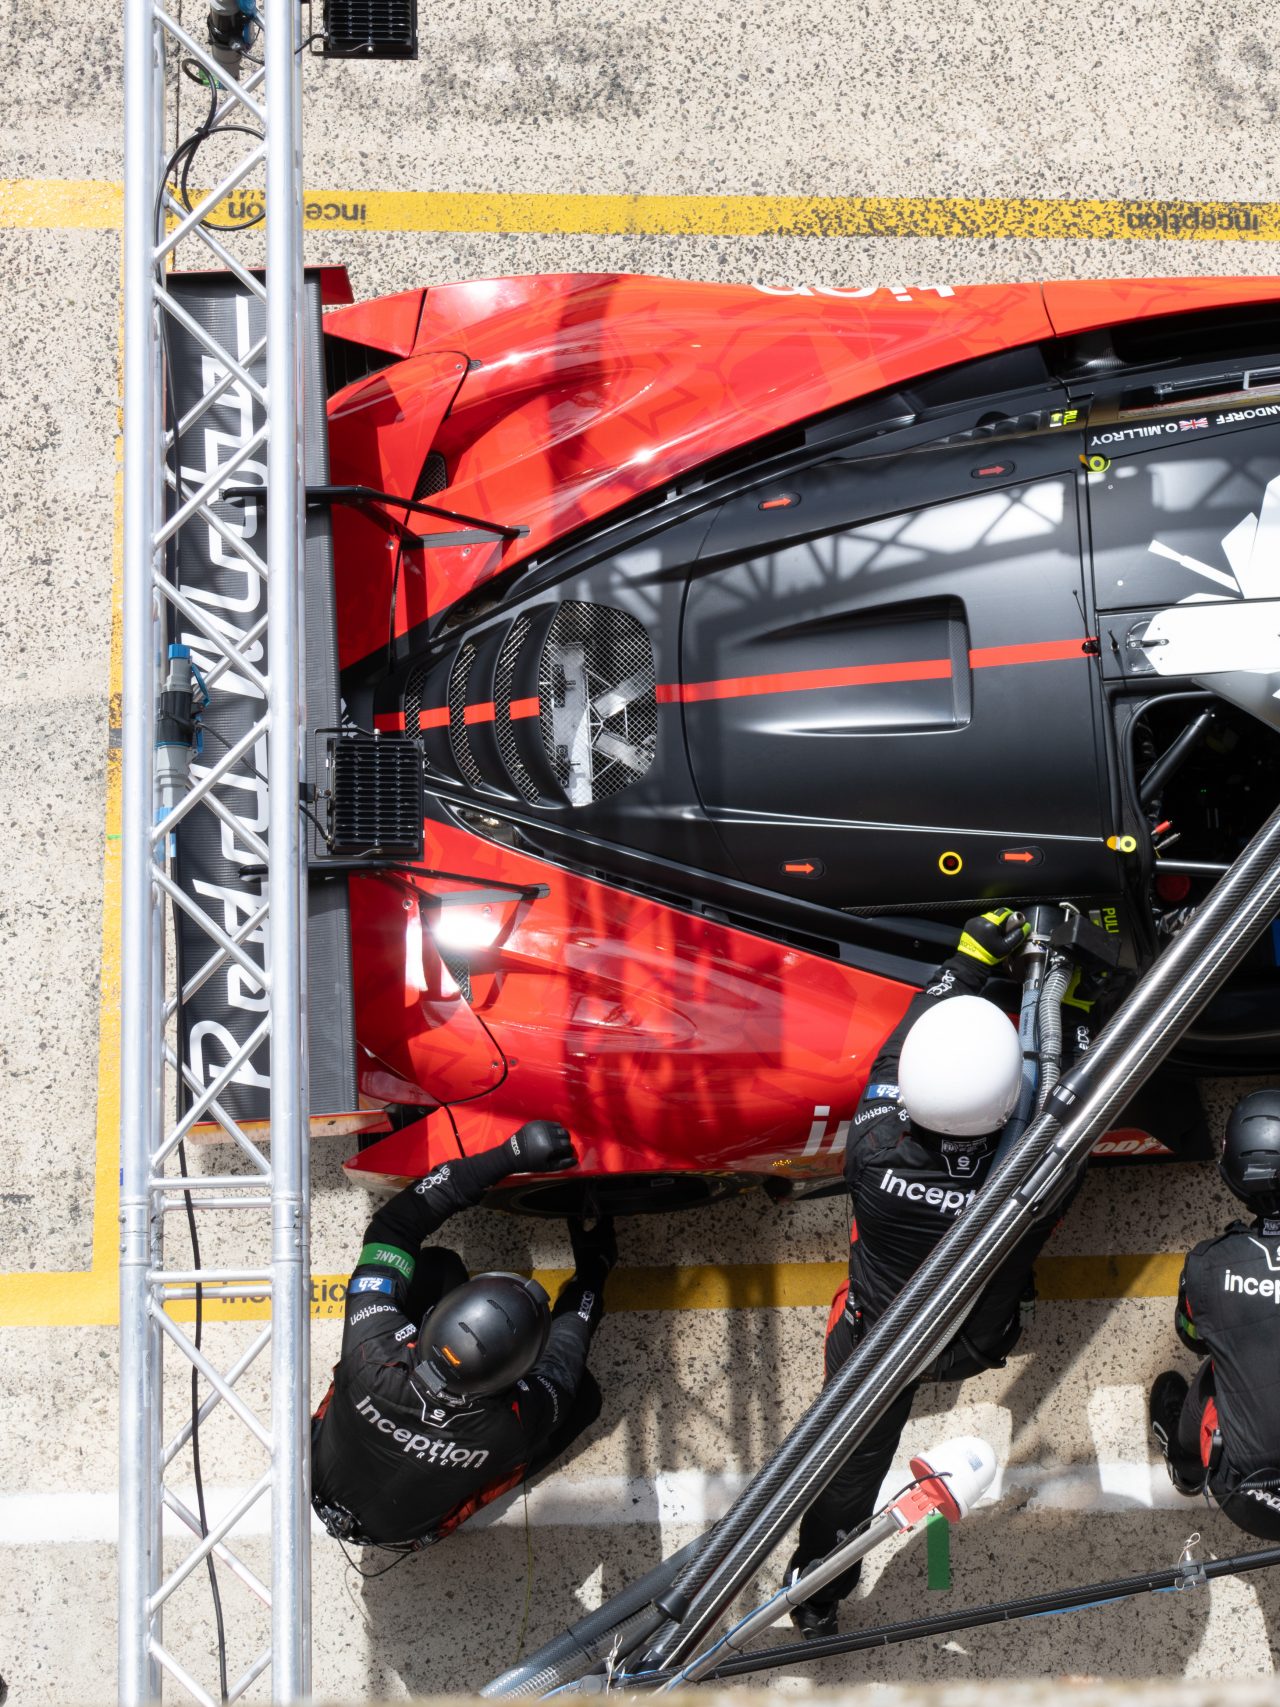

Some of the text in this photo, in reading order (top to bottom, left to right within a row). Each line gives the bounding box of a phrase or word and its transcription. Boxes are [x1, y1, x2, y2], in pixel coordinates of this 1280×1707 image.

[1126, 206, 1259, 234] inception
[1091, 422, 1179, 446] O.MILLROY
[355, 1395, 490, 1464] inception
